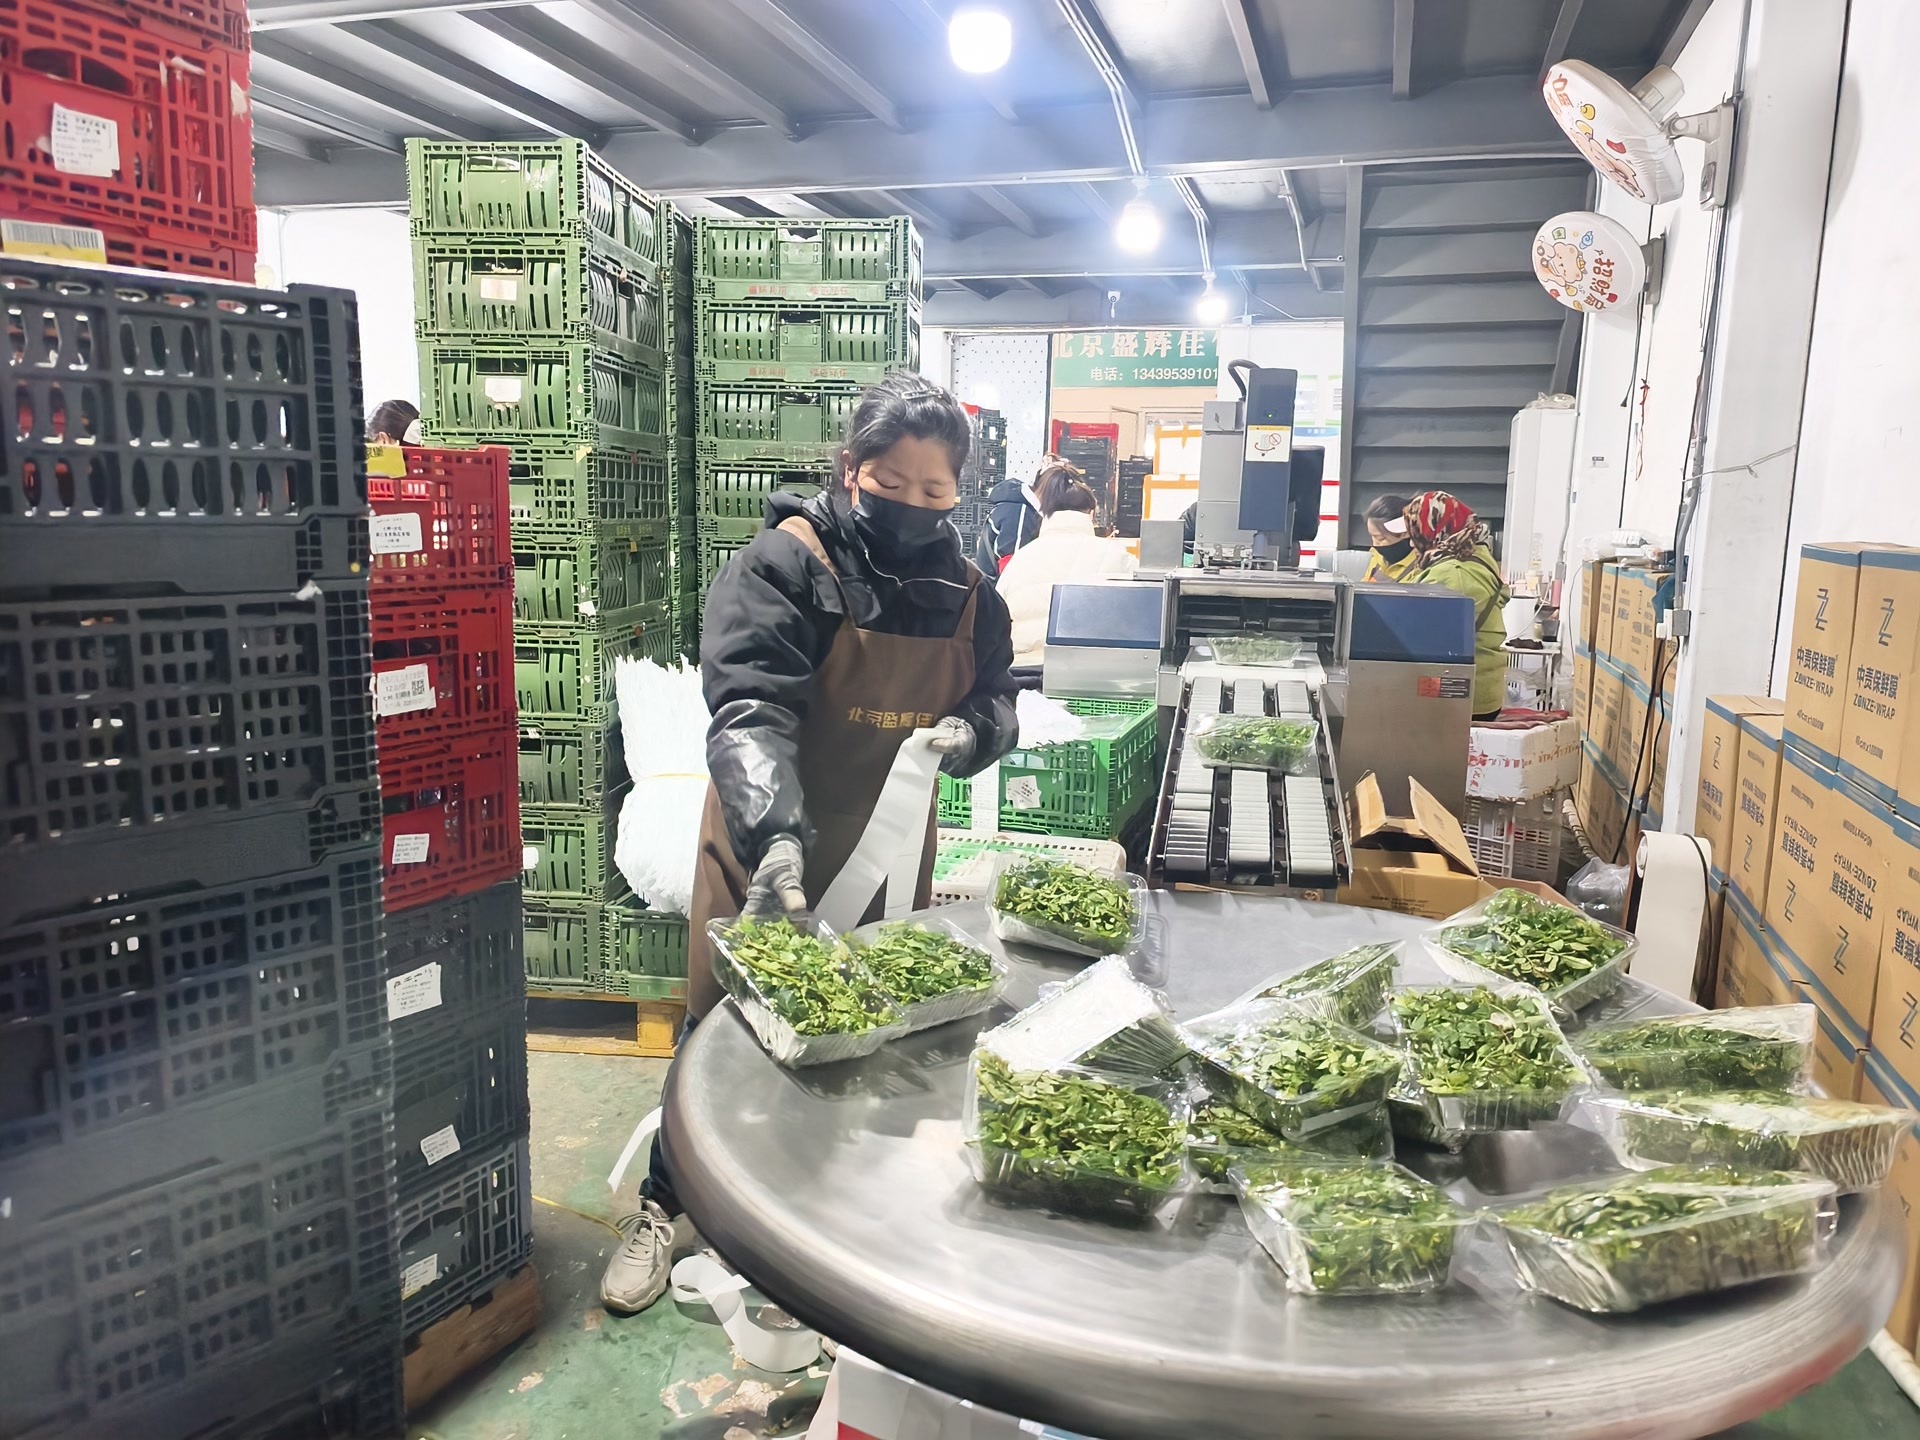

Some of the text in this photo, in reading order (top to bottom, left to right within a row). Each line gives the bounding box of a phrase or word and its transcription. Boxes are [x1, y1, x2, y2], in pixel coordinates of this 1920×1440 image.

[1053, 331, 1219, 357] 北京盛辉佳
[1132, 367, 1217, 380] 13439539101
